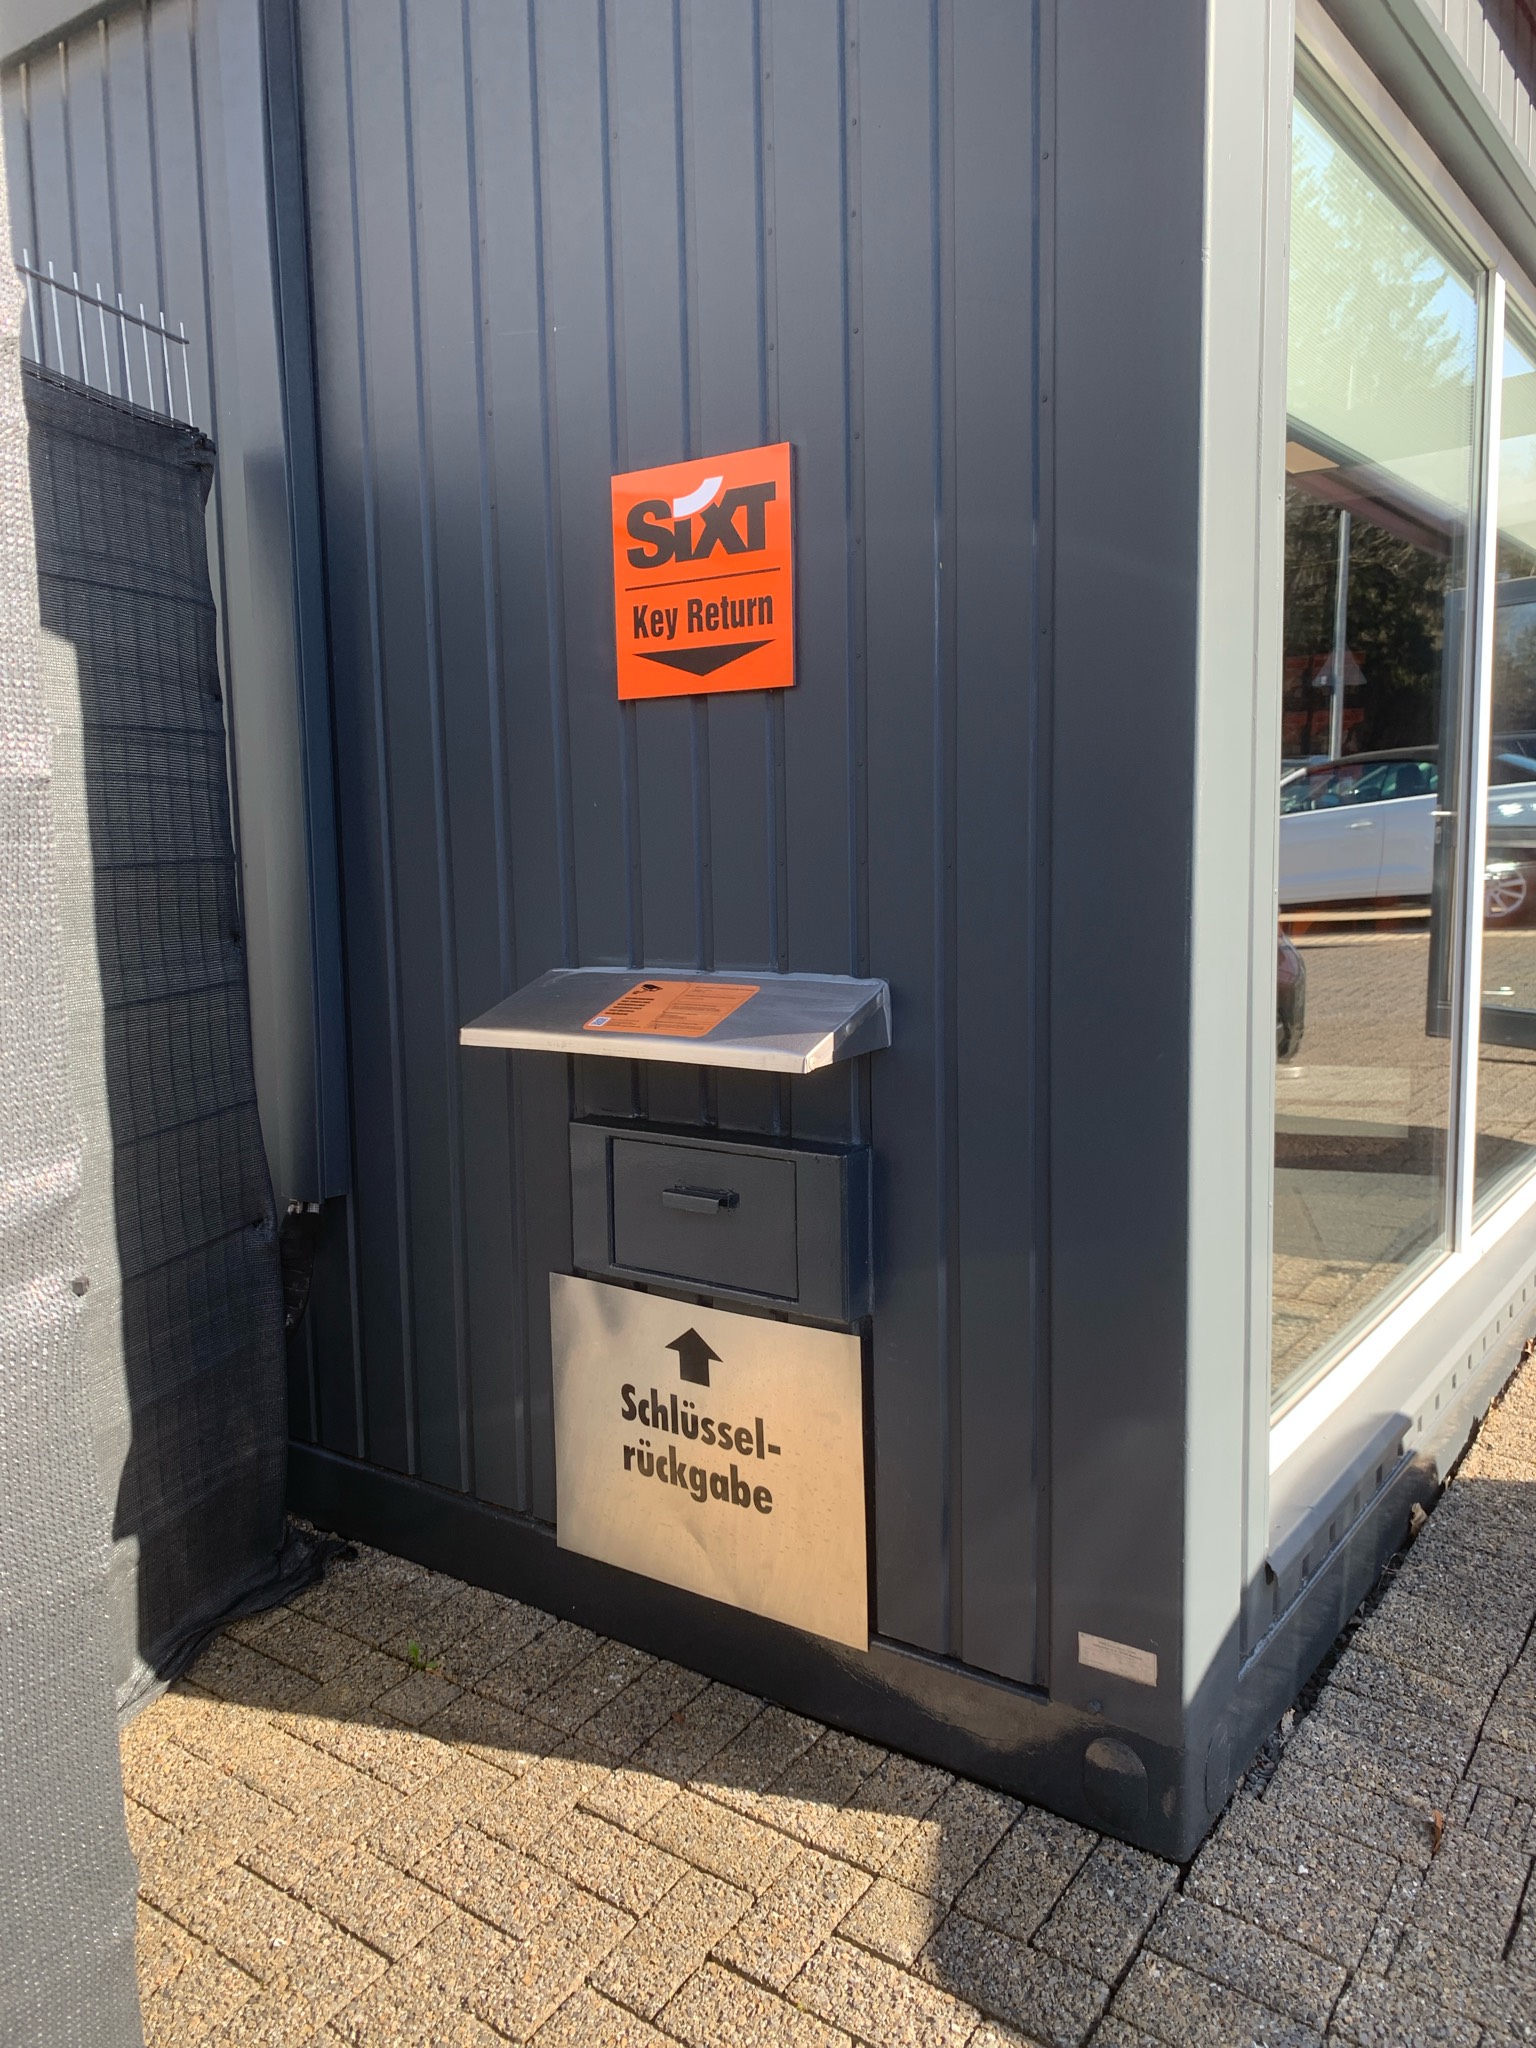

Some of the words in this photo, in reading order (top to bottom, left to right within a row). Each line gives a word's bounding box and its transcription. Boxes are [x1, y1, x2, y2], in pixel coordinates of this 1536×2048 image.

[633, 604, 678, 641] Key
[687, 594, 773, 634] Return
[621, 1383, 781, 1460] Schlüssel-
[623, 1438, 773, 1514] rückgabe
